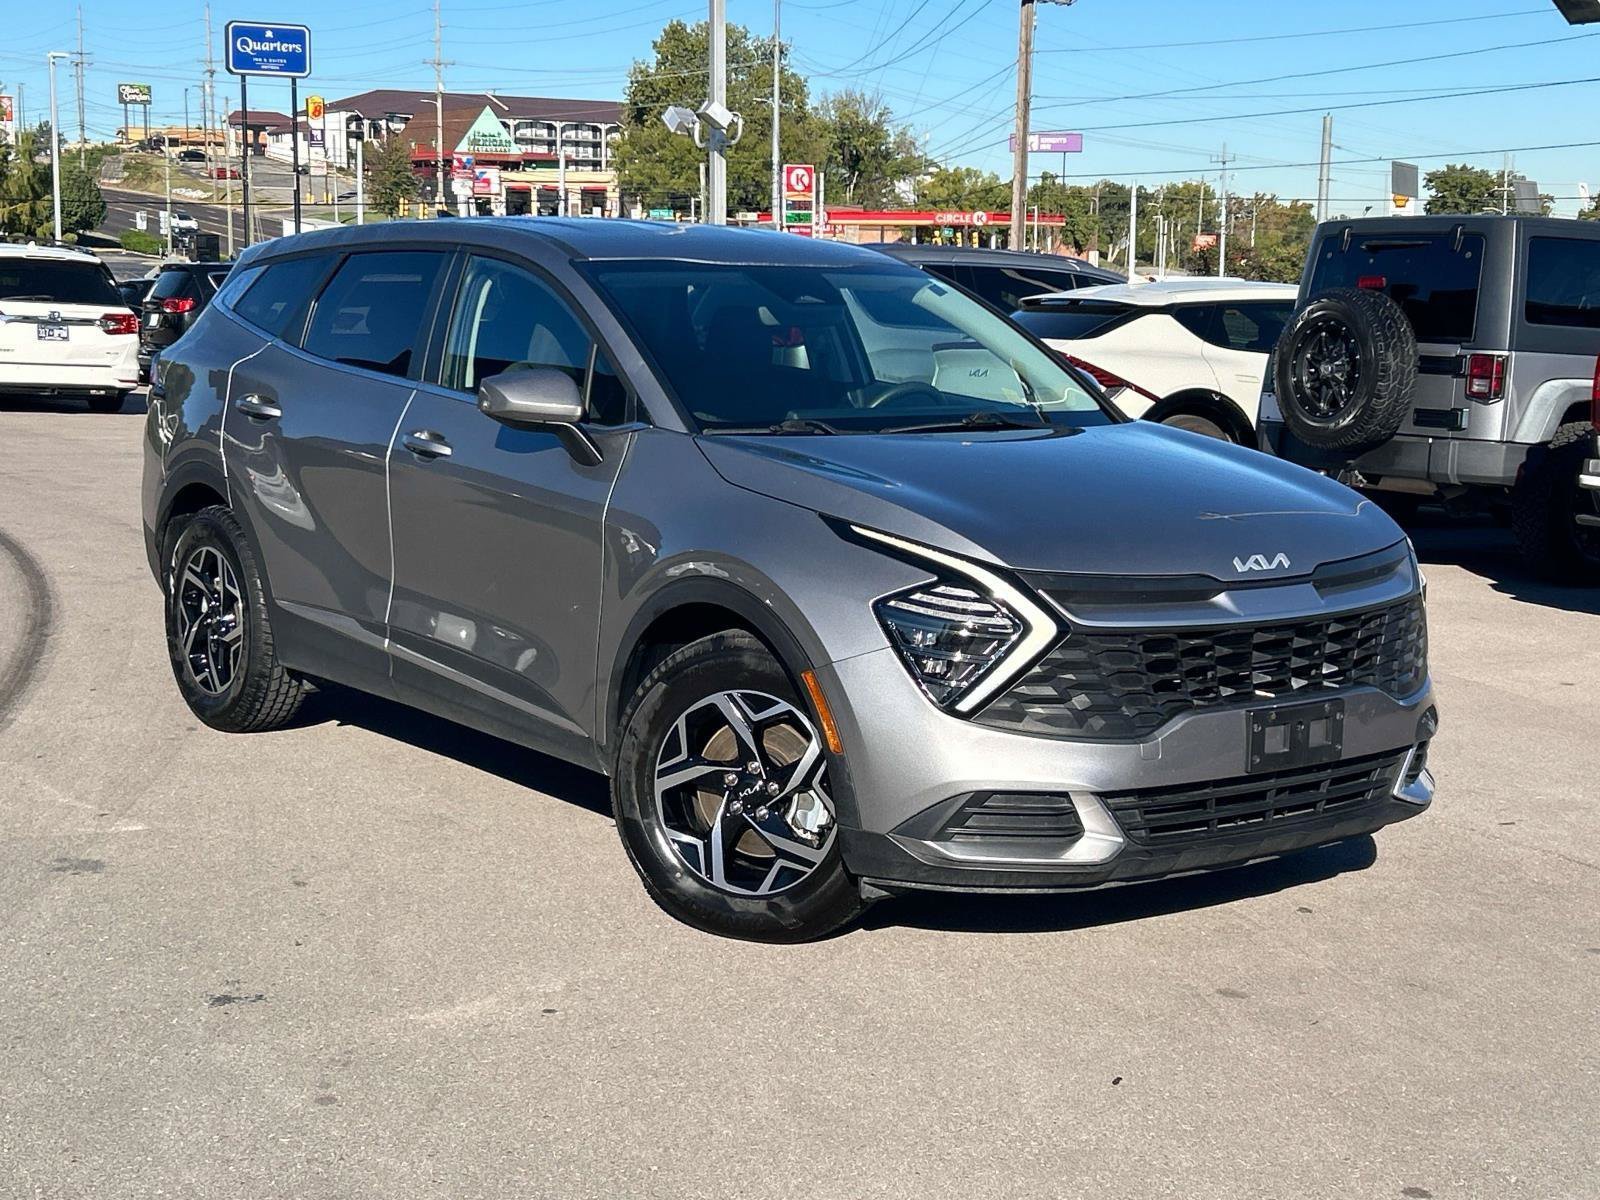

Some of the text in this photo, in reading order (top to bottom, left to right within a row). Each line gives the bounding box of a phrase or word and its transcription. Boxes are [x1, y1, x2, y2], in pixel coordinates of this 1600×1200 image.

[236, 36, 303, 55] Quarters
[795, 173, 807, 190] K
[935, 213, 972, 223] CIRCLE
[1232, 552, 1291, 573] KIA
